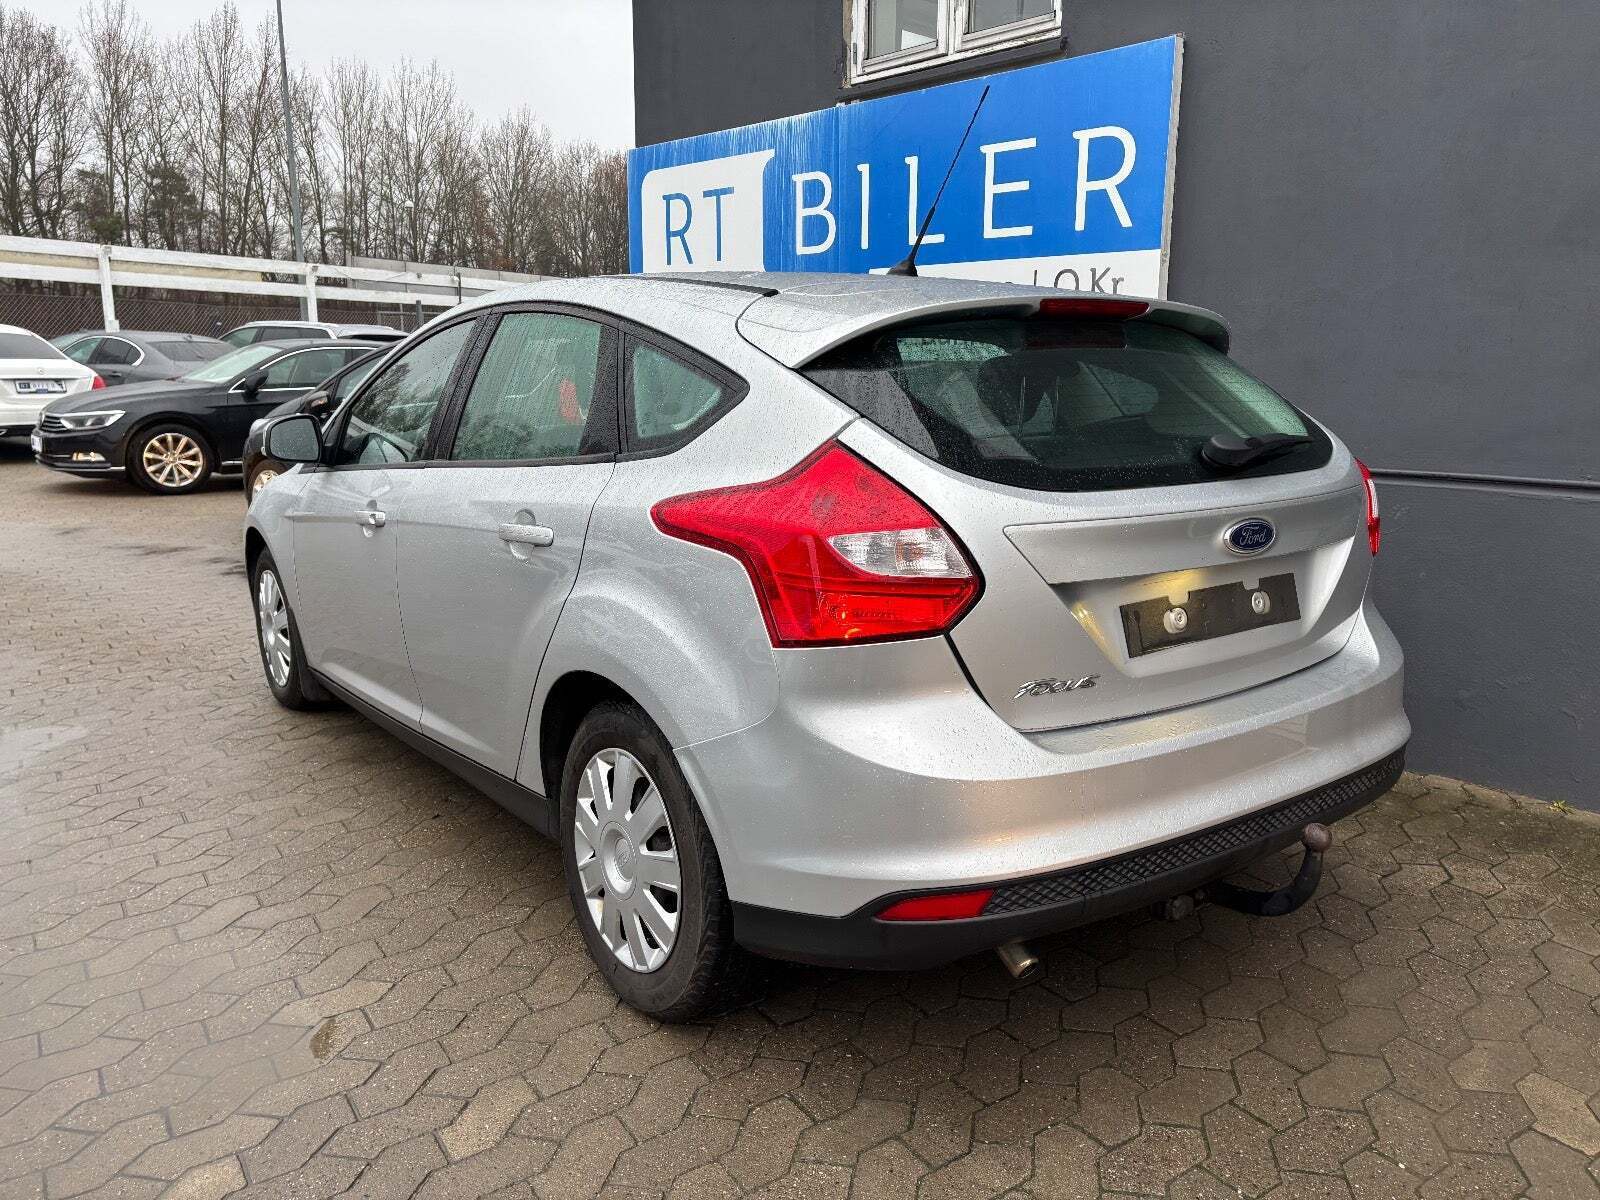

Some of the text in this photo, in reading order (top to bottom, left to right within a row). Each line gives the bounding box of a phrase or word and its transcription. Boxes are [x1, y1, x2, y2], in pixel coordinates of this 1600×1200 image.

[662, 125, 1137, 266] RT BILER
[1239, 525, 1268, 546] Ford
